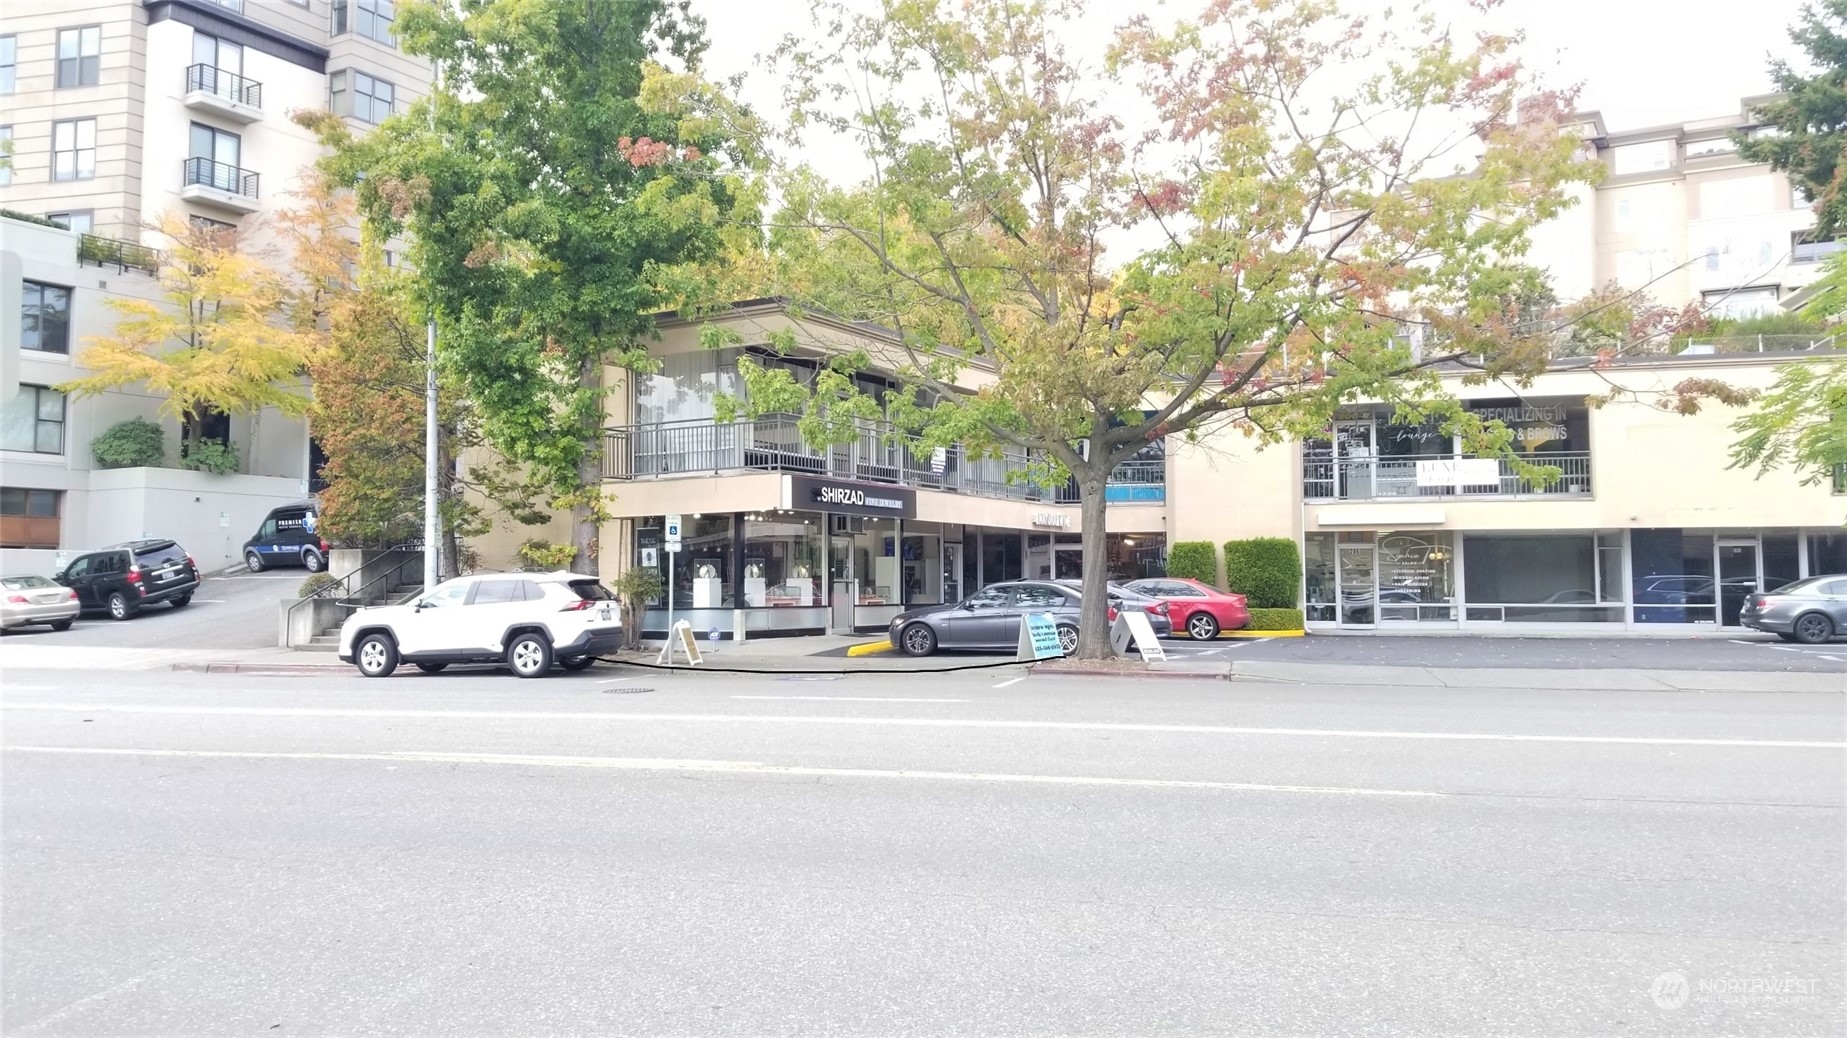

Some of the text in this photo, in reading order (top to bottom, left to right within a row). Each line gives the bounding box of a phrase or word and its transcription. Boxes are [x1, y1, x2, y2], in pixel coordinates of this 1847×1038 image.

[1473, 406, 1567, 422] SPECIALIZING IN
[1389, 430, 1441, 444] lounge
[1517, 428, 1525, 441] &
[1527, 427, 1568, 441] BROWS
[821, 487, 864, 505] SHIRZAD
